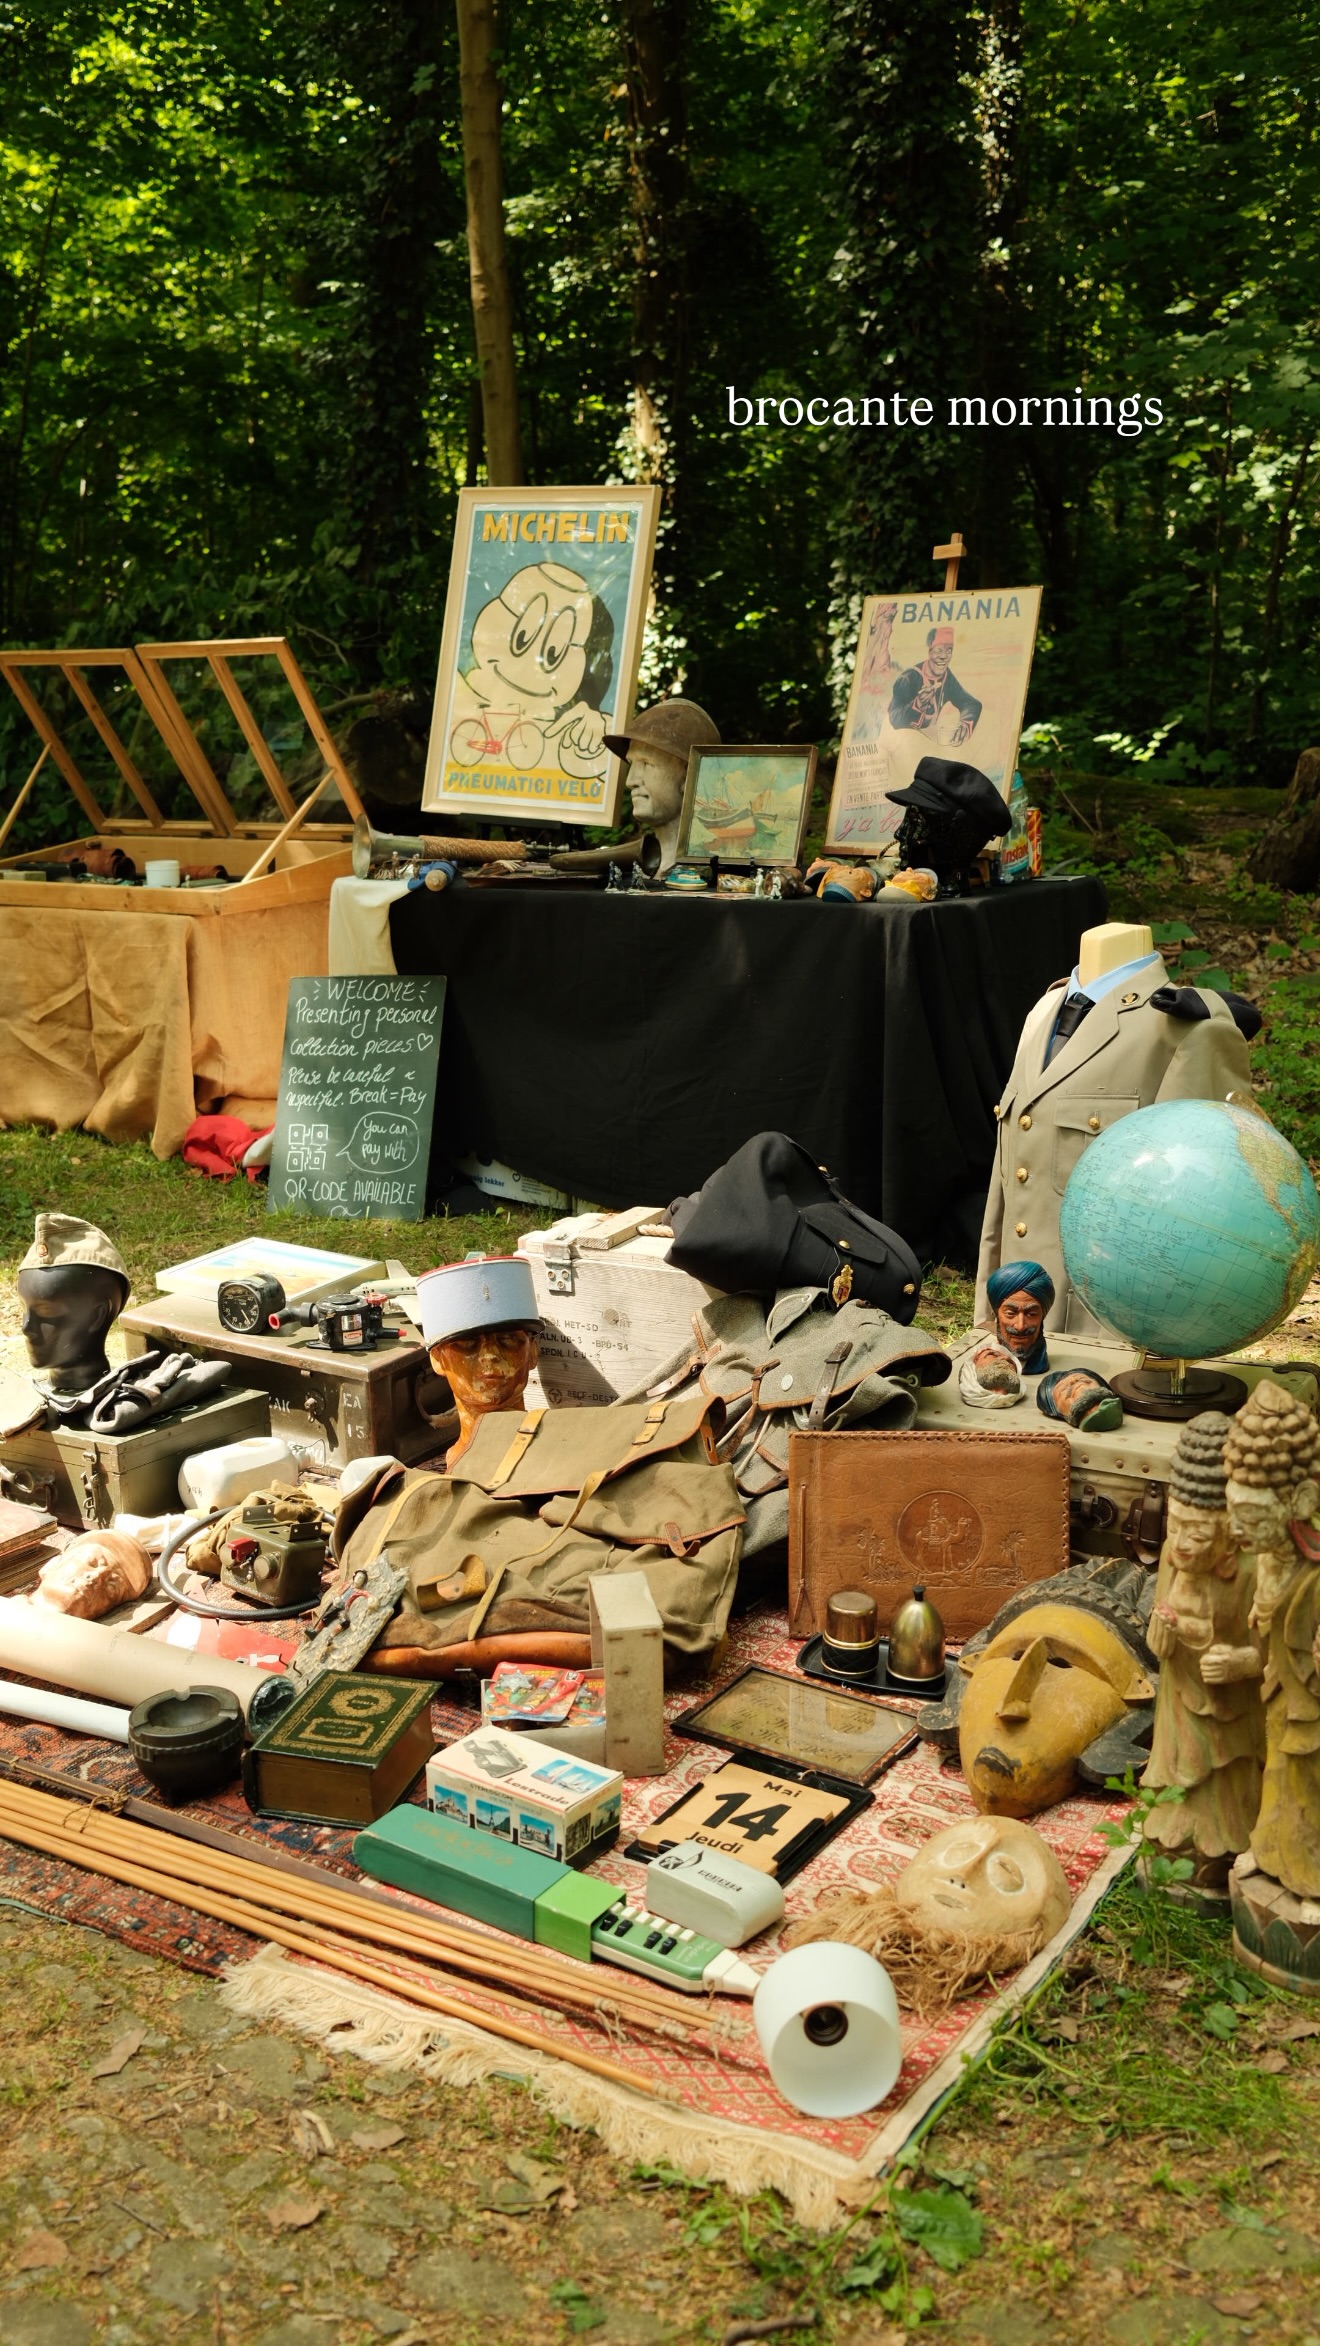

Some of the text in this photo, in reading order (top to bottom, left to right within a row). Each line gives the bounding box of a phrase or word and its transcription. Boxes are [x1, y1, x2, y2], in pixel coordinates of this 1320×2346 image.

[482, 512, 630, 544] MICHELIN
[901, 596, 1021, 623] BANANIA
[846, 743, 879, 759] BANANIA
[447, 770, 553, 794] PNEUMATICI
[328, 979, 418, 1001] WELCOME
[295, 997, 438, 1038] Presenting personal
[290, 1037, 359, 1057] Collection
[288, 1066, 321, 1085] Please
[326, 1067, 342, 1084] be
[343, 1064, 396, 1088] careful
[363, 1118, 408, 1140] You can
[361, 1141, 407, 1165] pay with
[284, 1178, 349, 1203] QR-CODE
[343, 1392, 362, 1410] EA
[346, 1423, 365, 1440] 15
[504, 1777, 569, 1805] Lestrade
[762, 1780, 803, 1799] Mai
[701, 1790, 792, 1841] 14
[684, 1831, 745, 1855] Jeudi
